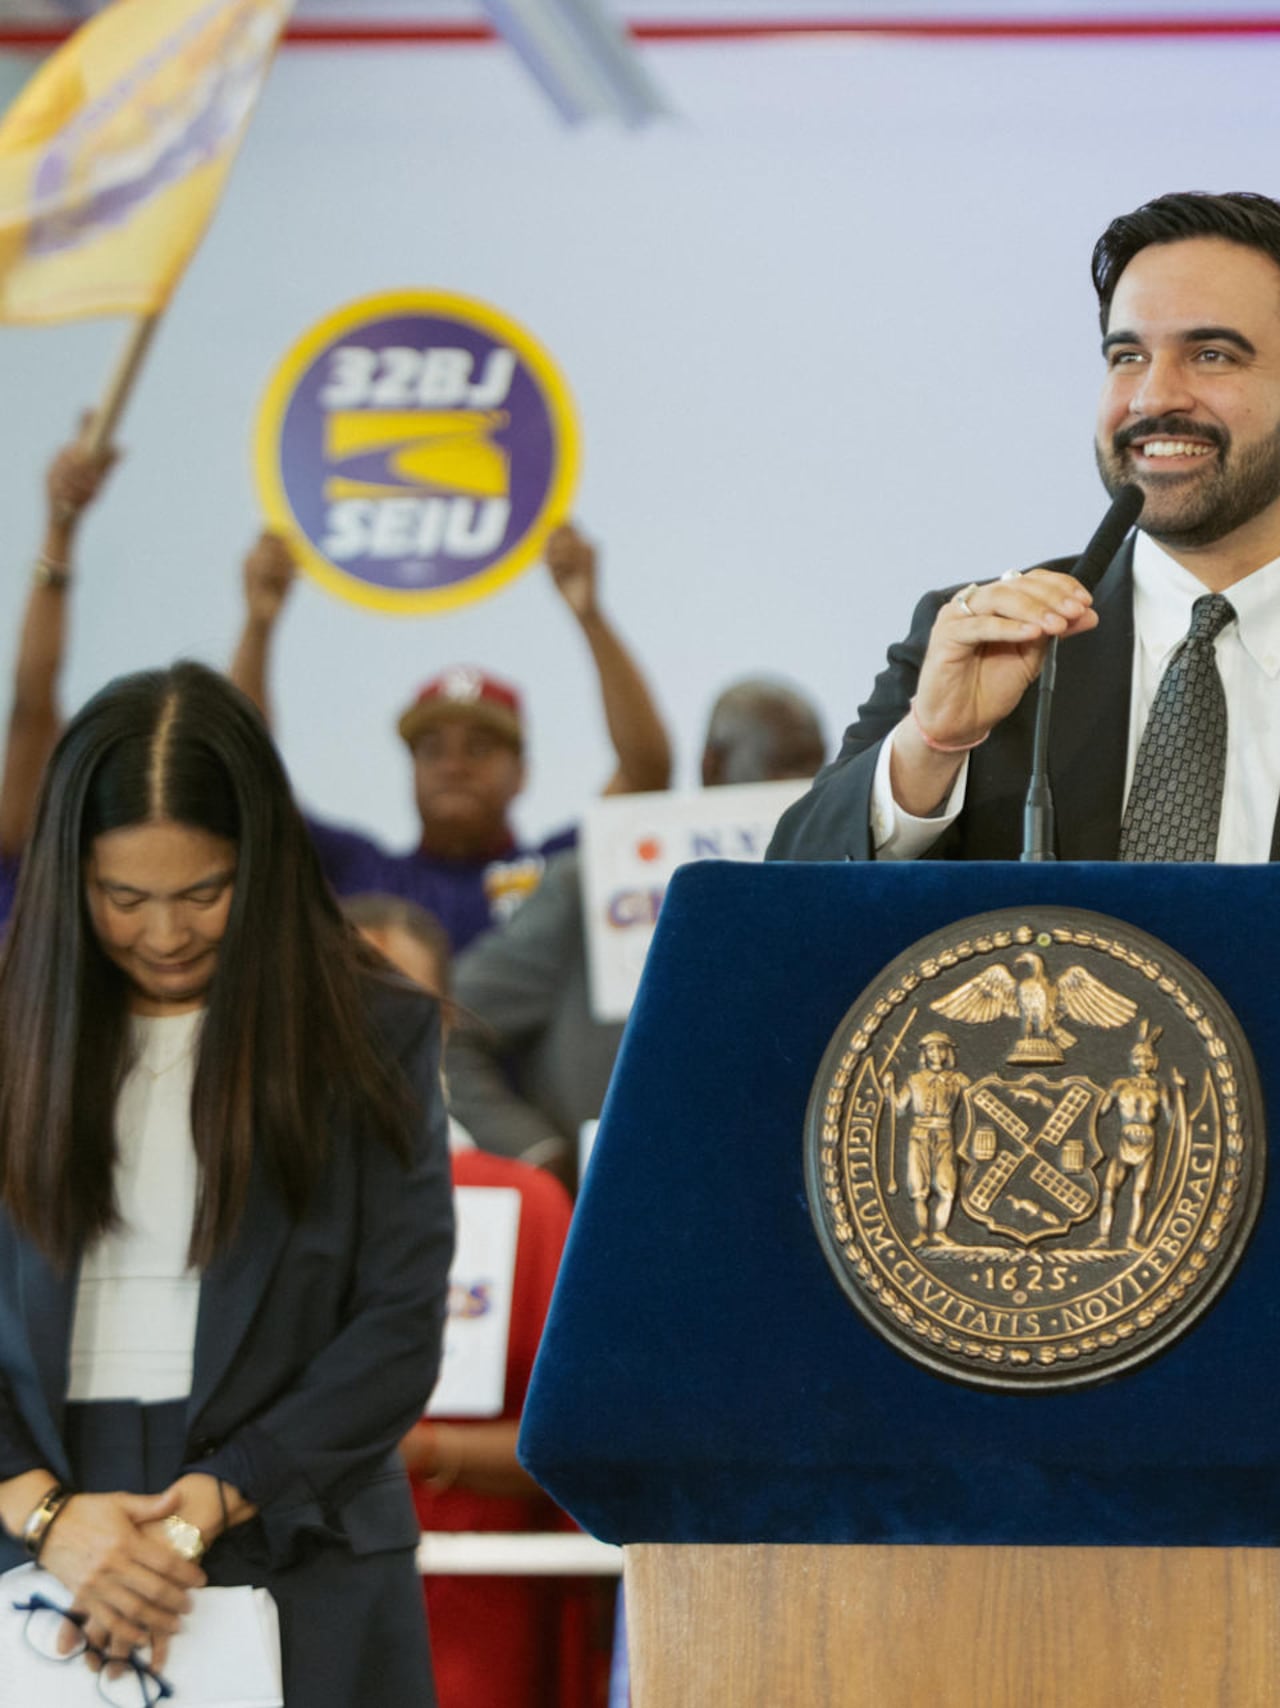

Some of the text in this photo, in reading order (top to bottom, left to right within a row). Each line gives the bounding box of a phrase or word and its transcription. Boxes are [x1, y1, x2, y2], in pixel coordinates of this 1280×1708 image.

[322, 346, 516, 408] 32BJ
[323, 499, 510, 559] SEIU
[848, 1098, 1216, 1337] SIGILLUM CIVITATIS NOVI EBORACI
[984, 1264, 1069, 1291] 1625
